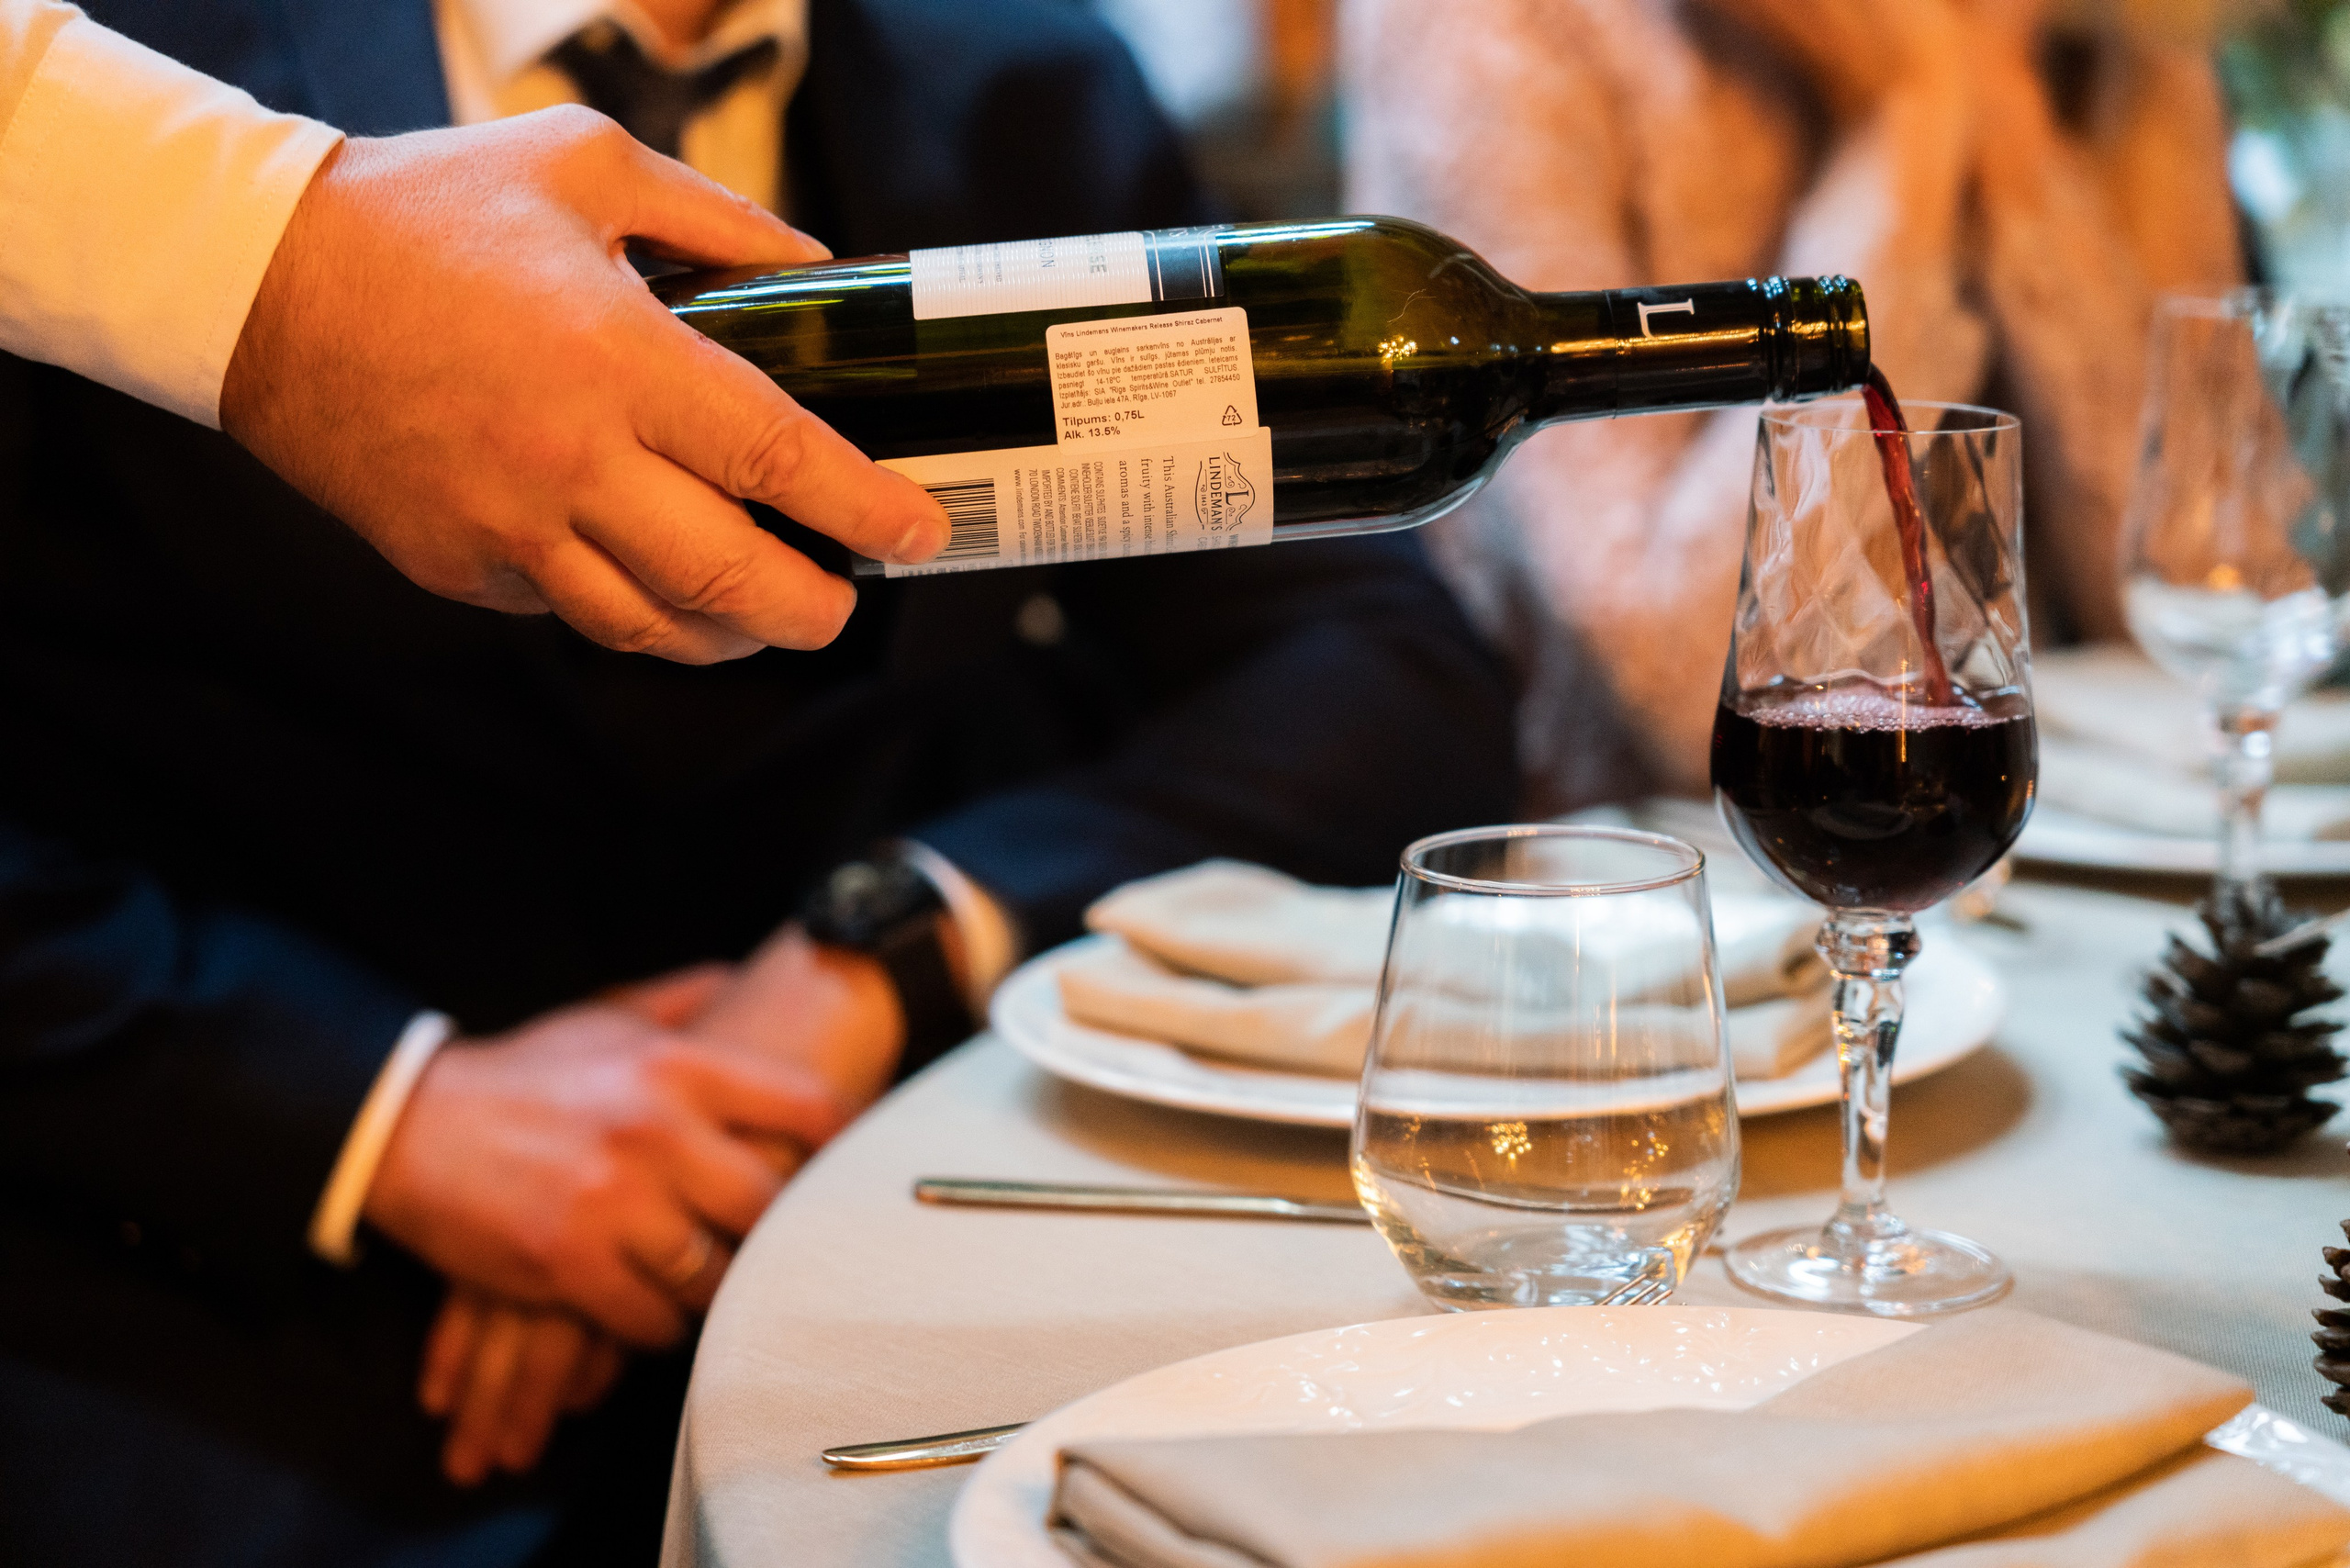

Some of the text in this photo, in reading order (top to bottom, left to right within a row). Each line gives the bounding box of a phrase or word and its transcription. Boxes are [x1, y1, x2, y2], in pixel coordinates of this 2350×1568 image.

[1076, 328, 1109, 336] Lindemans
[1110, 324, 1147, 333] Winemakers
[1195, 316, 1223, 324] Cabernet
[1637, 298, 1695, 340] L
[1057, 361, 1081, 369] klasisku
[1057, 370, 1085, 379] Izbaudiet
[1112, 366, 1122, 375] pie
[1155, 362, 1175, 370] pastas
[1208, 354, 1238, 364] Ieteicams
[1058, 380, 1085, 390] pasniegt
[1116, 395, 1132, 403] 47A,
[1150, 389, 1177, 399] LV-1067
[1129, 381, 1169, 392] Spirits&Wine
[1062, 409, 1145, 428] Tilpums: 0,75L
[1064, 426, 1121, 440] Alk. 13.5%
[1094, 462, 1104, 488] CONTAINS
[1119, 461, 1129, 498] aromas
[1139, 459, 1153, 488] fruity
[1163, 456, 1175, 481] This
[1030, 477, 1040, 501] LONDON
[1042, 470, 1052, 498] IMPORTED
[1069, 469, 1080, 494] CONTIENE
[1014, 469, 1024, 530] www.lindemans.com
[1096, 489, 1105, 513] SULPHITES
[1143, 492, 1155, 512] with
[1209, 457, 1222, 531] LINDEMAN'S
[1225, 490, 1248, 505] L
[1032, 503, 1041, 517] ROAD
[1045, 509, 1054, 519] AND
[1058, 504, 1067, 524] Attention
[1122, 501, 1134, 517] and
[1165, 485, 1177, 528] Australian
[1120, 527, 1133, 543] spicy
[1145, 515, 1154, 539] intense
